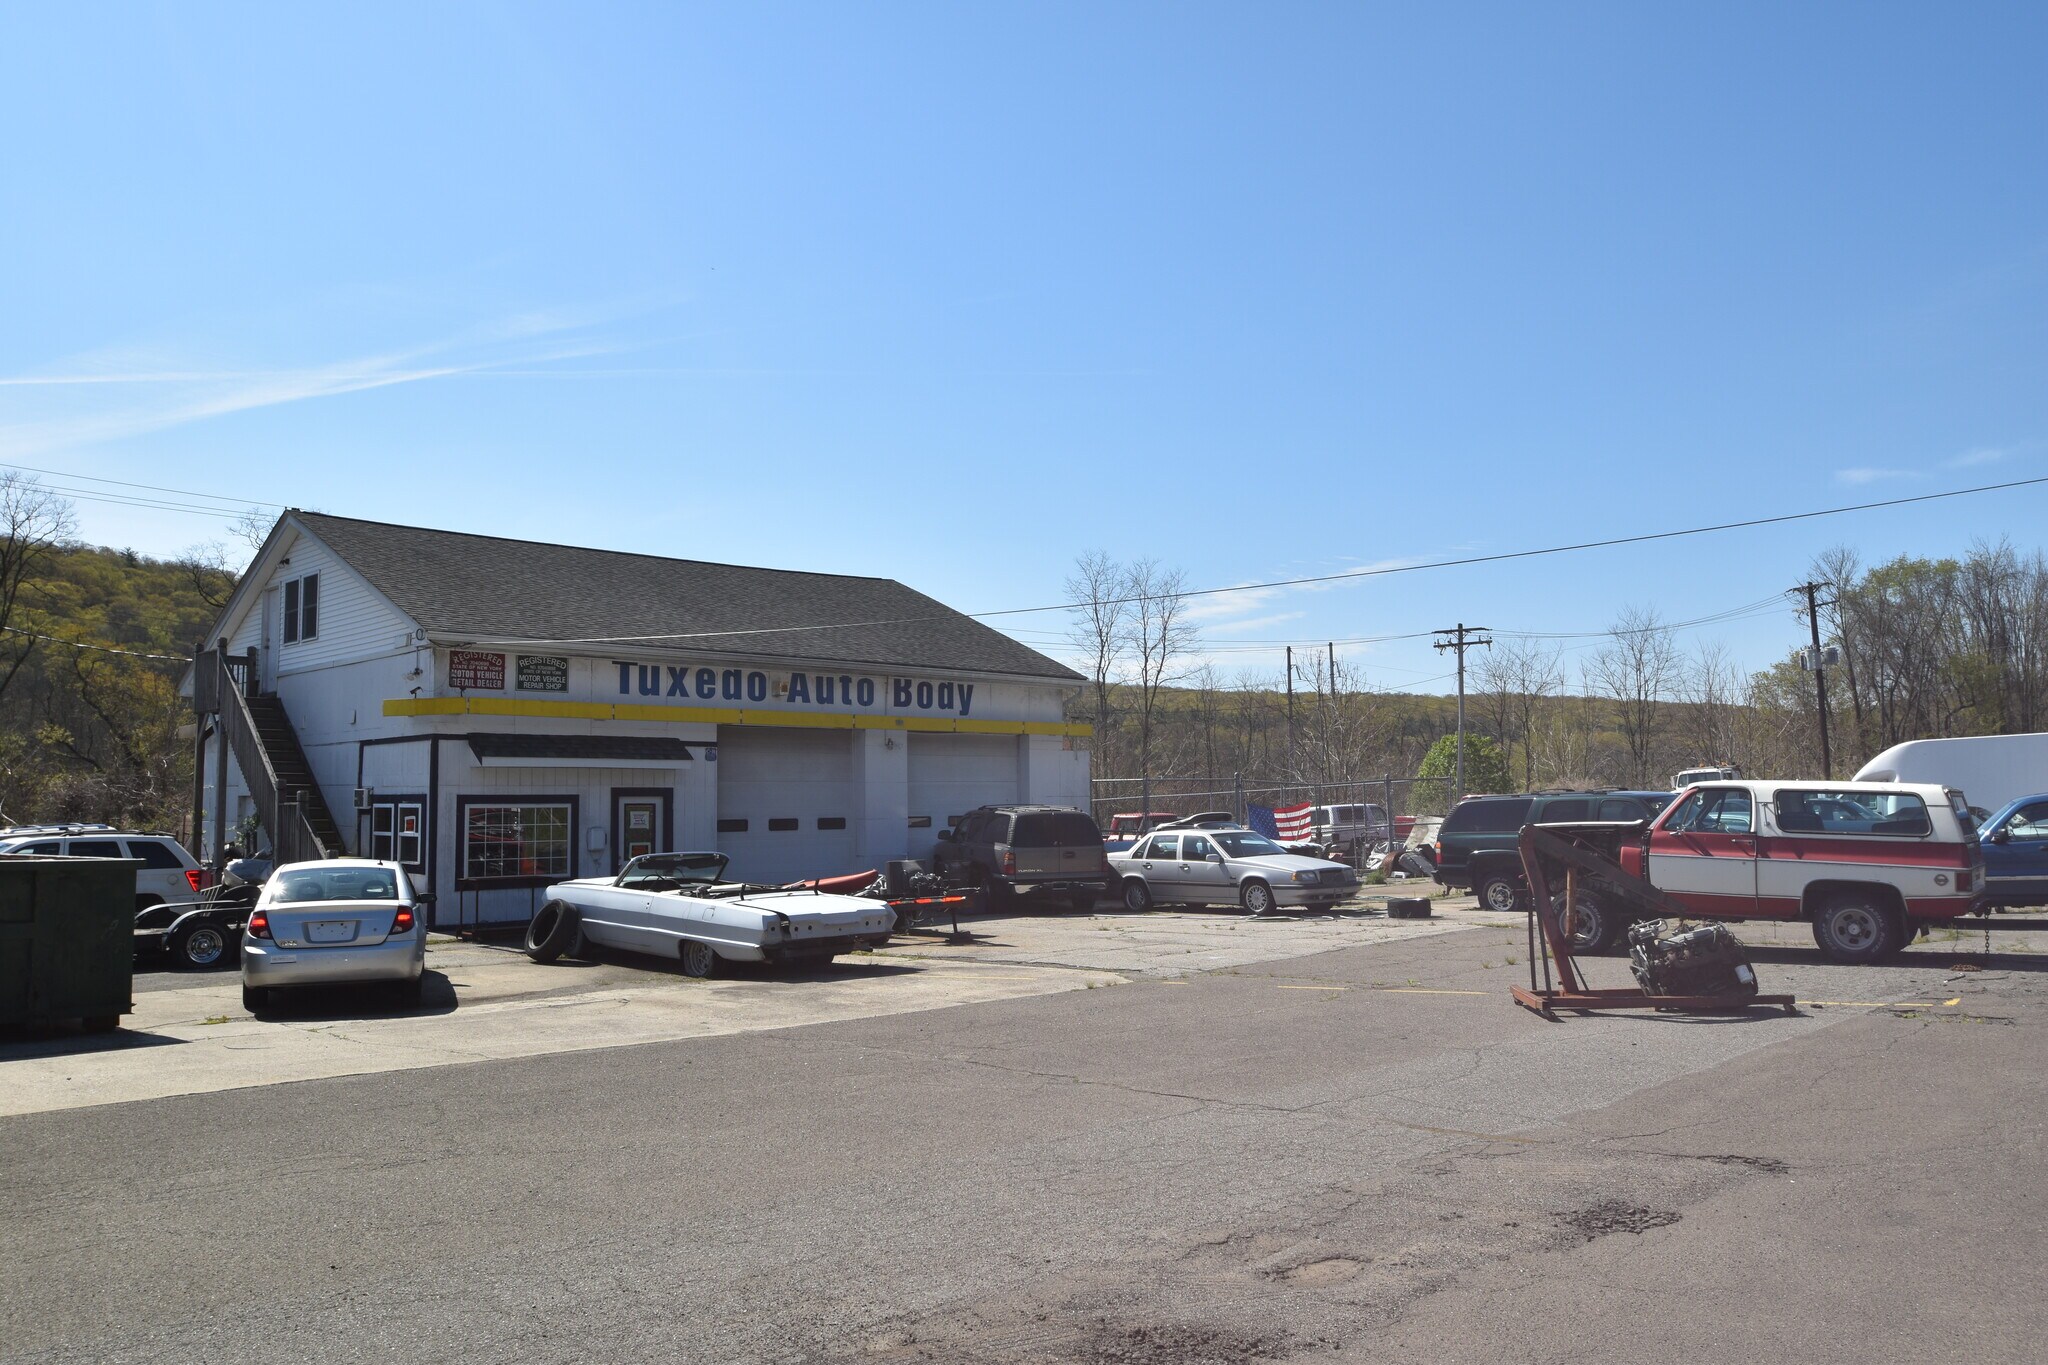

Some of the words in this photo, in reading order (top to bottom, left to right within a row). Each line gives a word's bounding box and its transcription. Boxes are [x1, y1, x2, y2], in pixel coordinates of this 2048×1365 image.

[453, 651, 502, 666] REGISTERED
[519, 656, 567, 670] REGISTERED
[451, 669, 474, 678] MOTOR
[477, 670, 503, 680] VEHICLE
[519, 674, 541, 682] MOTOR
[542, 675, 566, 683] VEHICLE
[477, 679, 502, 688] DEALER
[612, 660, 767, 702] Tuxedo
[787, 672, 875, 707] Auto
[893, 678, 974, 716] Body
